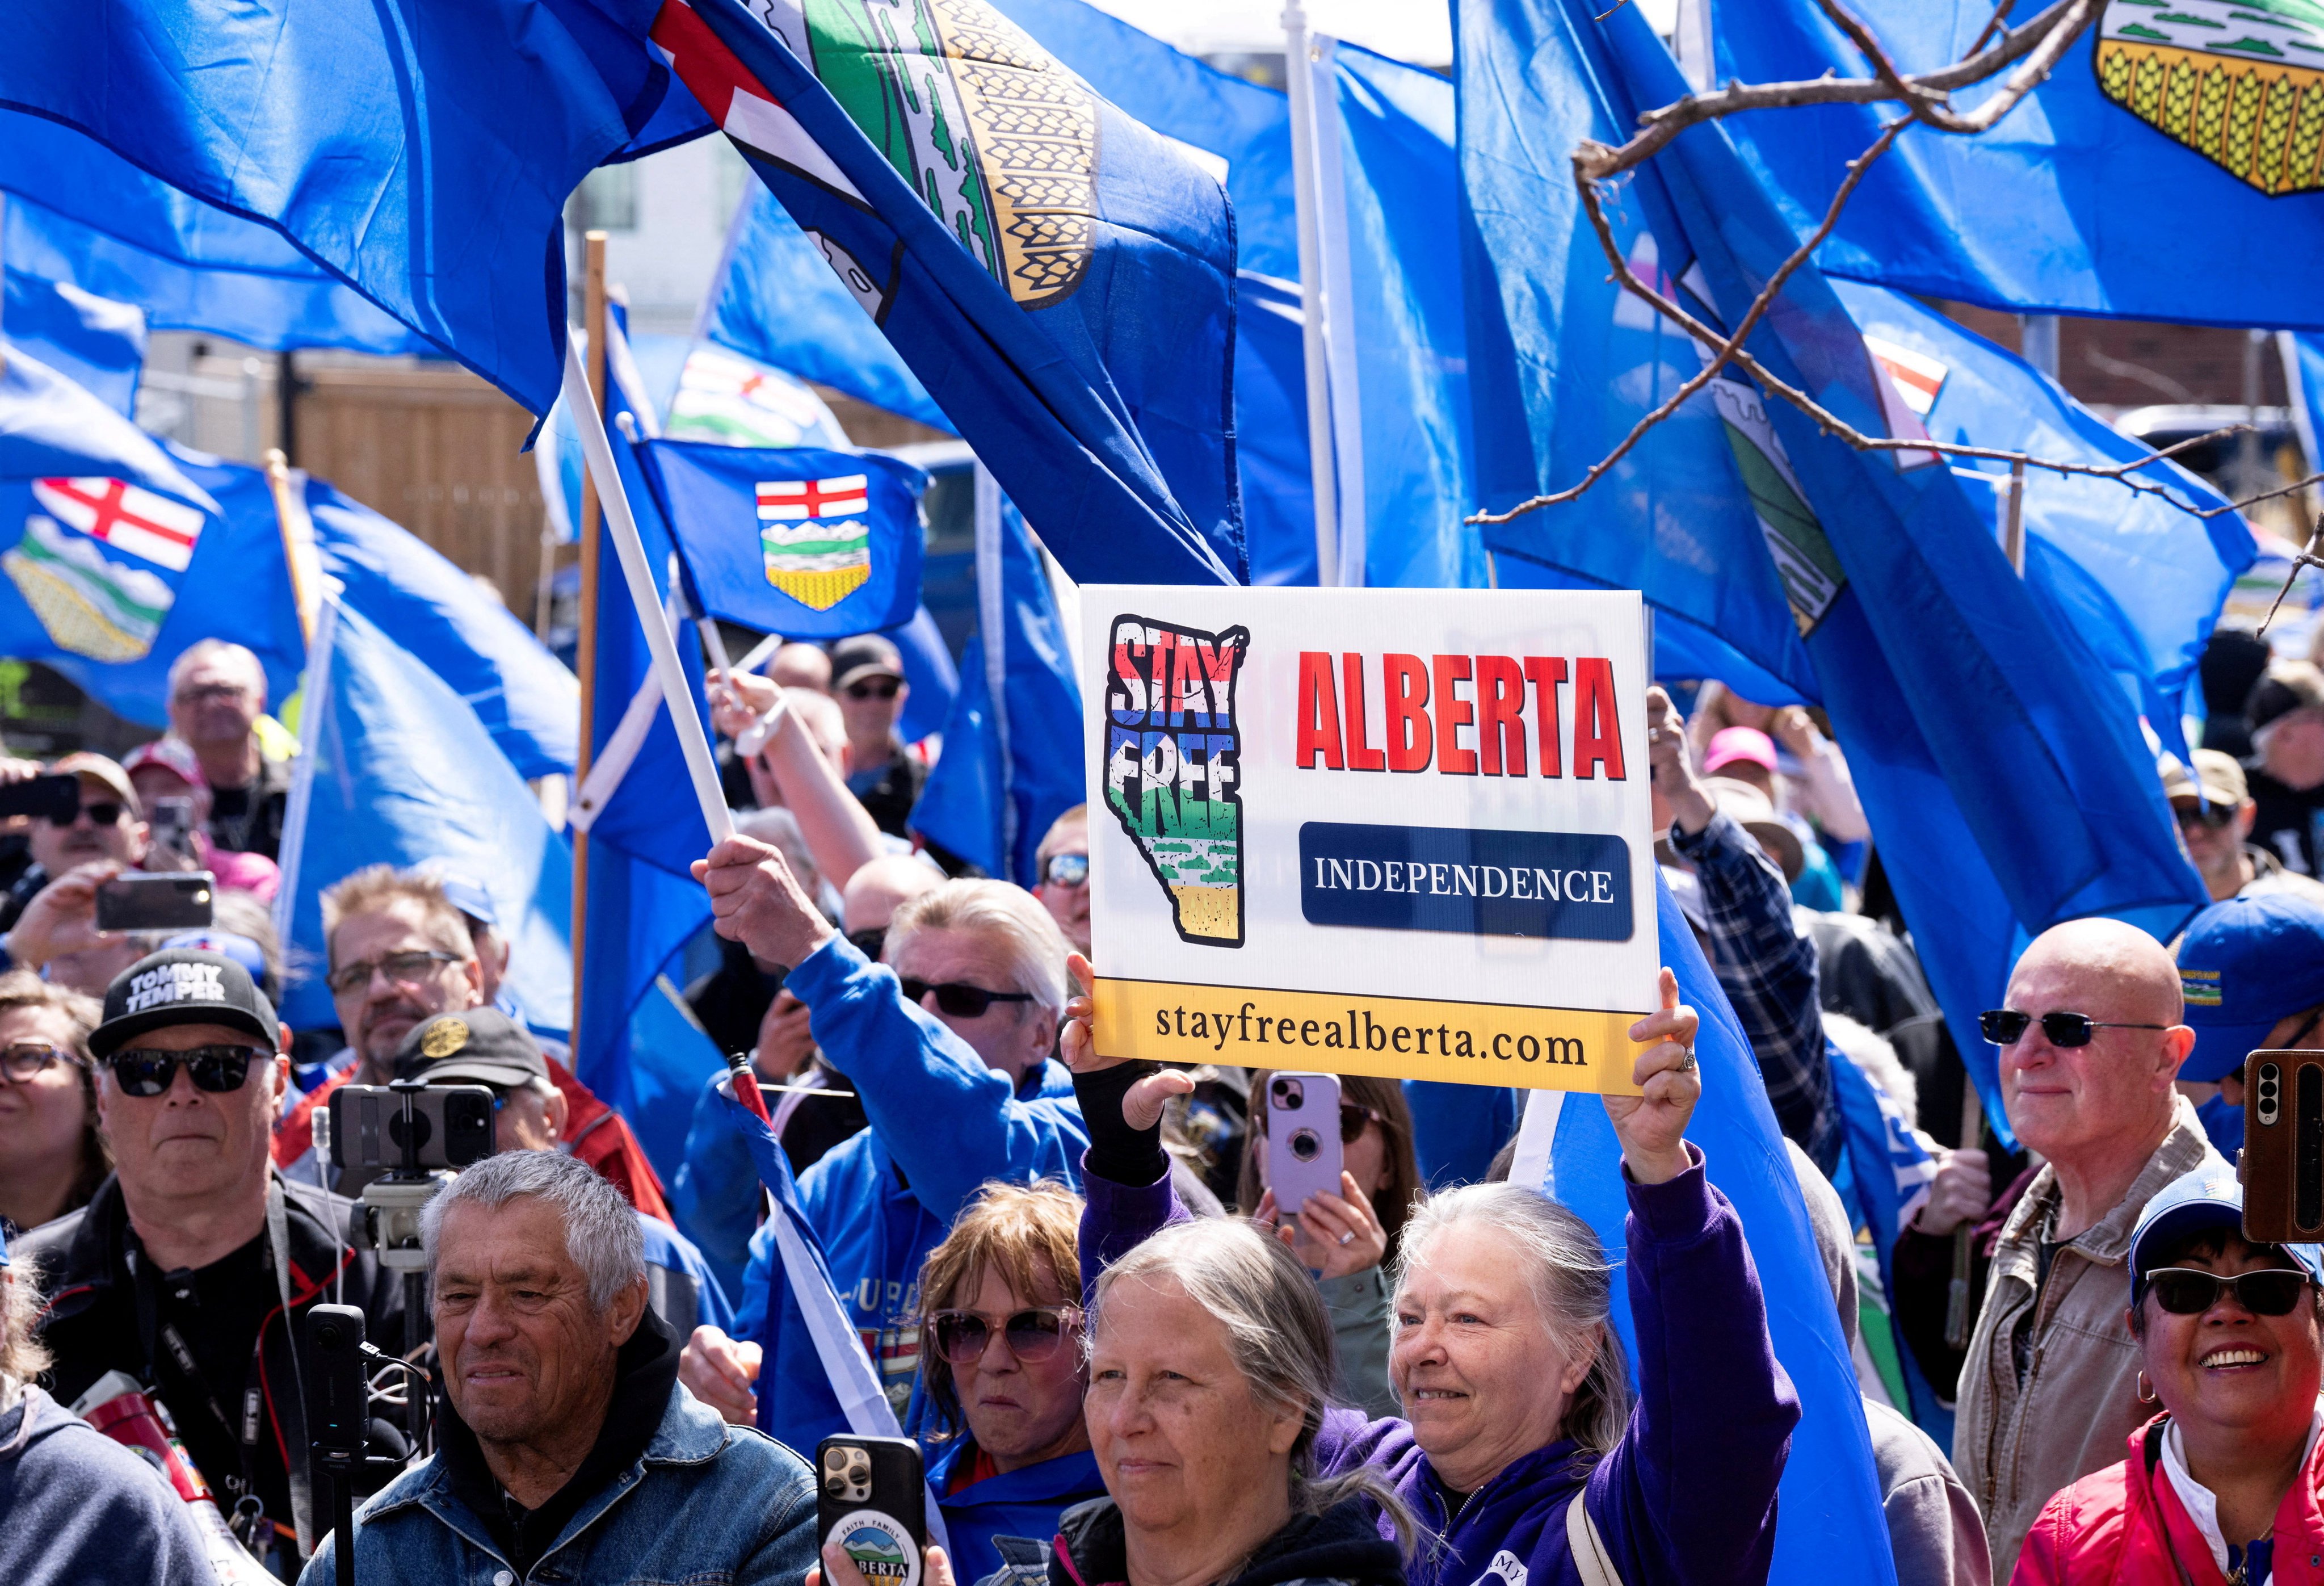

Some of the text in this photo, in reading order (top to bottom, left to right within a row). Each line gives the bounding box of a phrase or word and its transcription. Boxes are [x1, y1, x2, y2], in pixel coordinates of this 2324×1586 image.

[1111, 622, 1237, 729] STAY
[1296, 651, 1627, 781] ALBERTA
[1108, 725, 1237, 837] FREE
[1314, 857, 1614, 903] INDEPENDENCE
[126, 981, 226, 1014] TEMPER
[130, 962, 223, 995] TOMMY
[1156, 1002, 1588, 1065] stayfreealberta.com
[842, 1520, 901, 1539] FAITH FAMILY
[858, 1560, 907, 1578] BERTA
